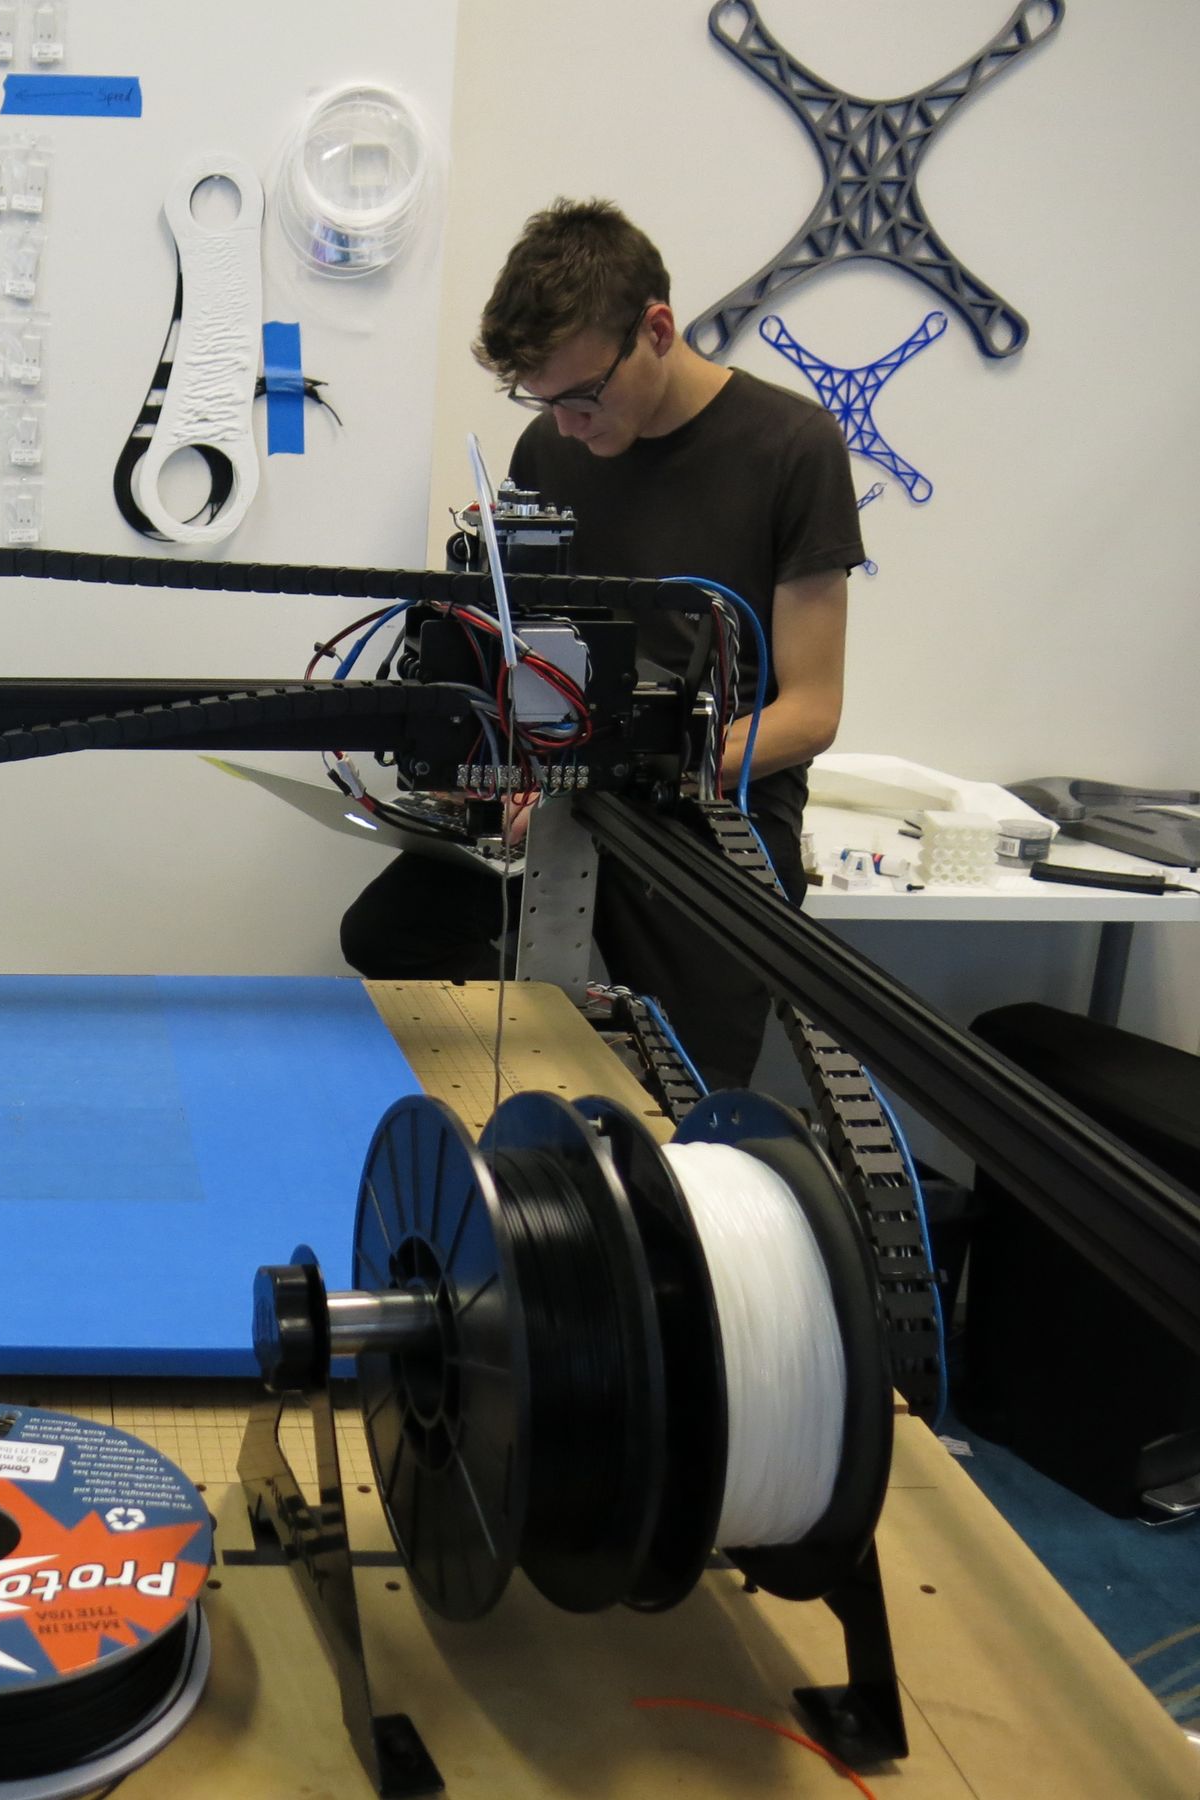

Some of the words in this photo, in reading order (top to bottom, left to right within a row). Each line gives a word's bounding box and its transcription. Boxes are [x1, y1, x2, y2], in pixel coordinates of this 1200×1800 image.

[40, 1424, 62, 1432] great
[83, 1427, 105, 1435] think
[60, 1434, 103, 1444] packaging
[105, 1437, 127, 1445] With
[99, 1445, 144, 1454] integrated
[80, 1452, 96, 1460] and
[135, 1456, 158, 1465] level
[93, 1461, 133, 1471] diameter
[134, 1464, 157, 1473] large
[72, 1468, 88, 1476] has
[90, 1469, 111, 1478] form
[85, 1477, 116, 1486] unique
[72, 1485, 89, 1494] and
[92, 1496, 134, 1505] designed
[174, 1492, 185, 1500] be
[145, 1499, 169, 1508] spool
[171, 1501, 192, 1509] This
[35, 1608, 74, 1621] USA
[79, 1604, 119, 1618] THE
[38, 1621, 59, 1635] IN
[64, 1617, 121, 1633] MADE
